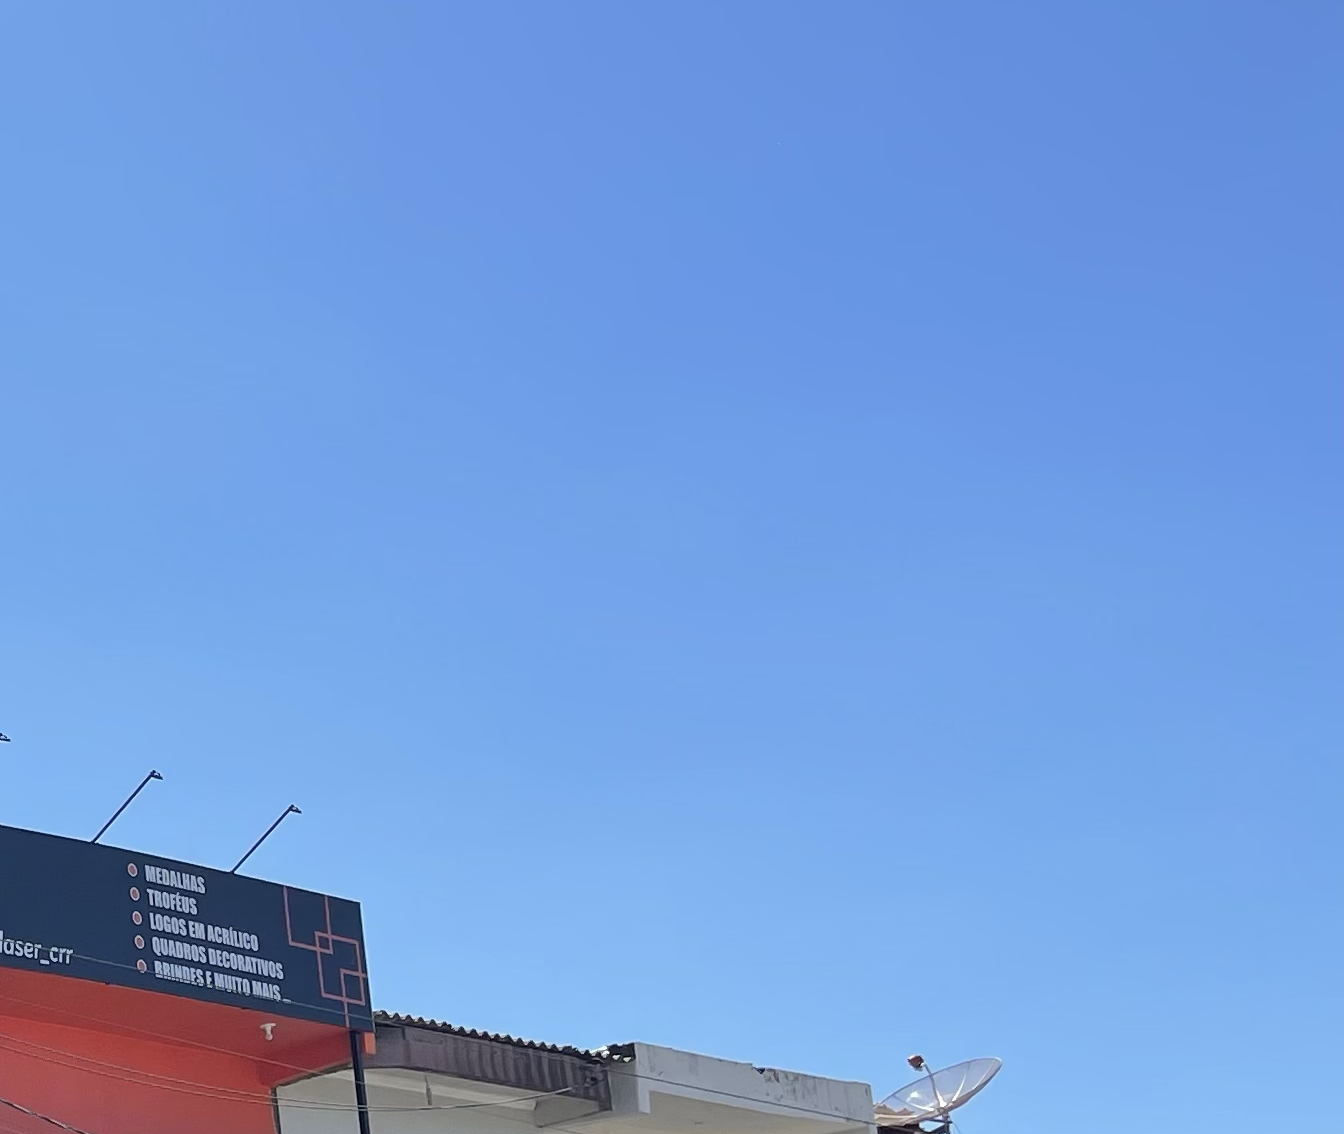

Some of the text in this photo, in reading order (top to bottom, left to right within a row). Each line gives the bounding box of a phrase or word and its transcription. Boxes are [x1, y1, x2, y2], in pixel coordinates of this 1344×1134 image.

[144, 864, 206, 894] MEDALHAS
[146, 888, 198, 915] TROFÉUS
[149, 912, 259, 952] LOGOS EM ACRÍLICO
[151, 936, 284, 980] QUADROS DECORATIVOS
[154, 960, 204, 986] BRINDES
[206, 970, 213, 988] E
[214, 972, 250, 996] MUITO
